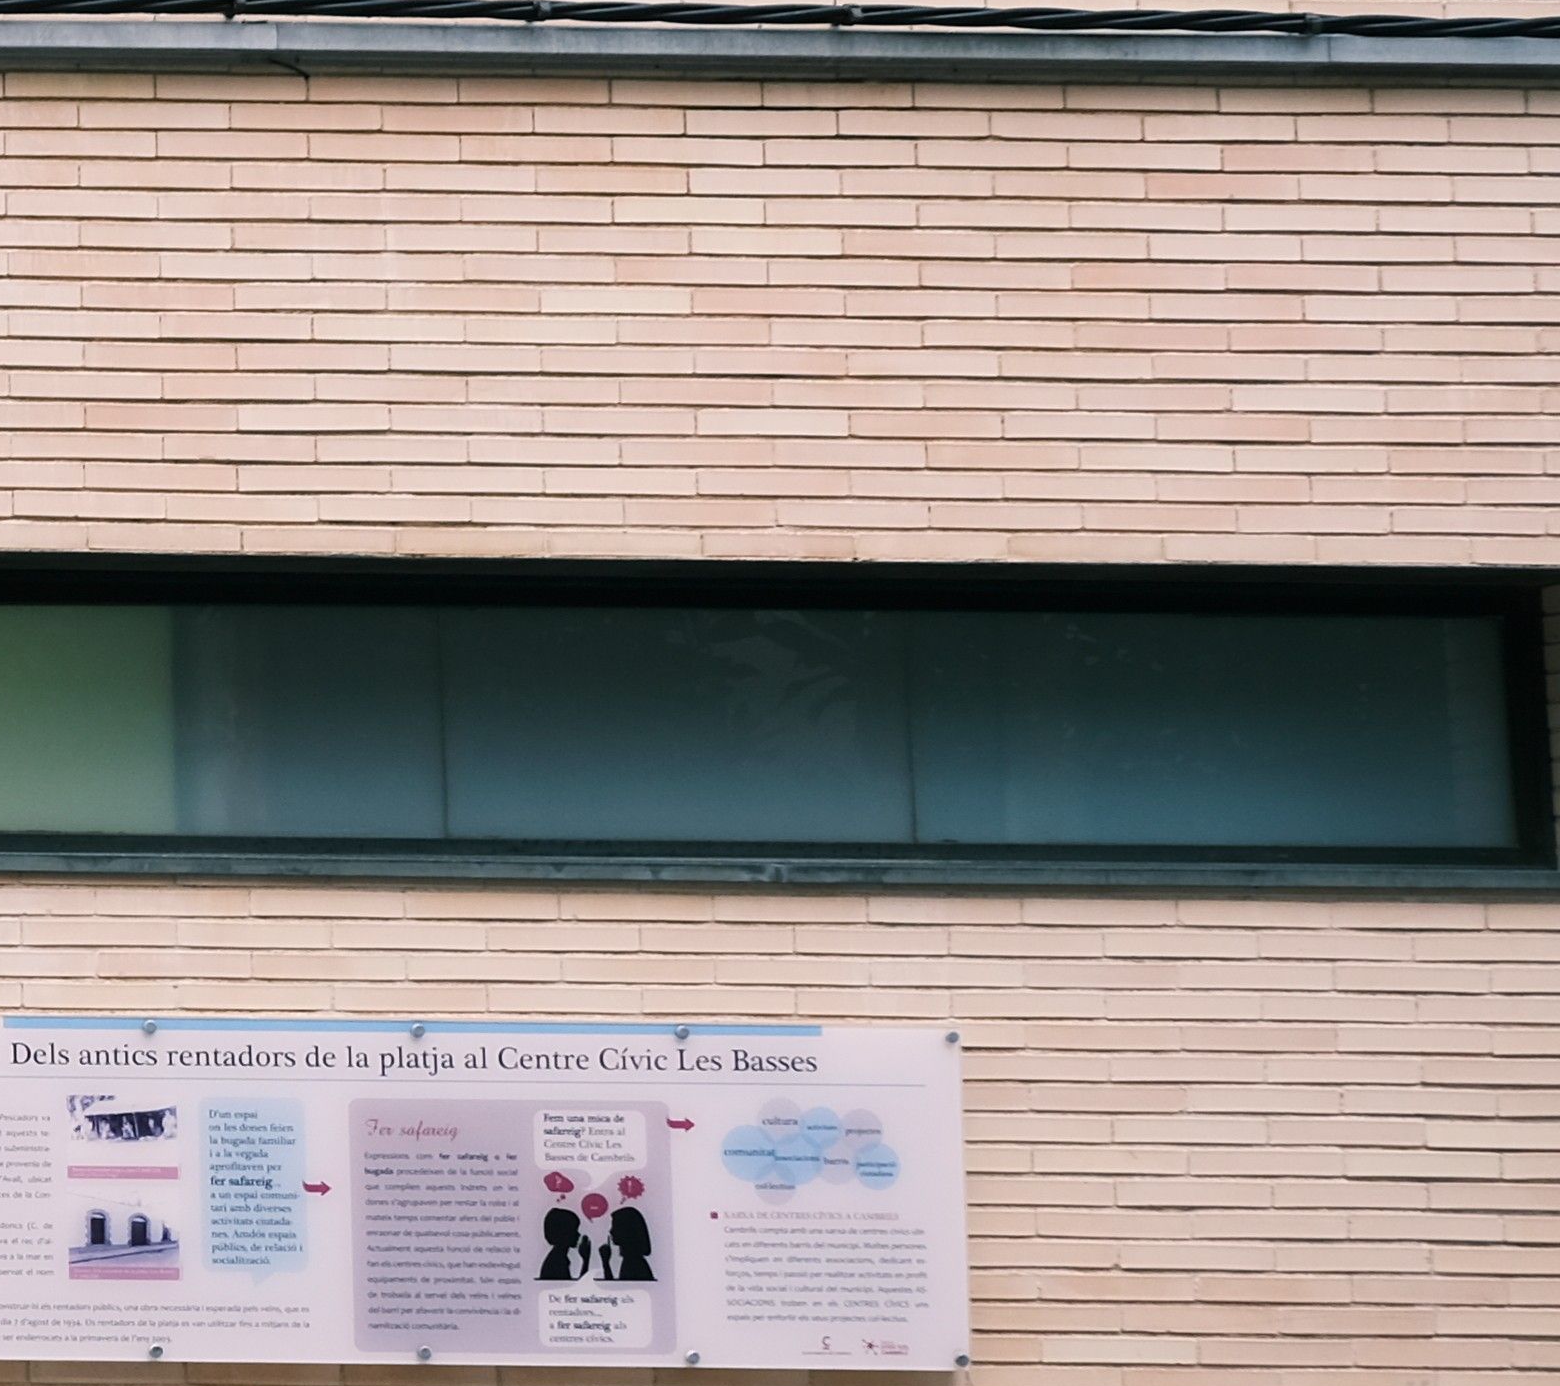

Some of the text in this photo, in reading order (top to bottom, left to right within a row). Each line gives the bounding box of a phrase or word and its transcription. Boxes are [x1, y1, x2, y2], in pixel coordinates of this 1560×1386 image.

[11, 1041, 818, 1076] Dels antics rentadors de la platja al Centre Cívic Les Basses
[234, 1111, 258, 1121] espai
[762, 1117, 798, 1126] cultura
[239, 1124, 268, 1132] dones
[364, 1119, 459, 1141] Fer safareig
[210, 1136, 296, 1147] la bugada familiar
[211, 1176, 225, 1186] fer
